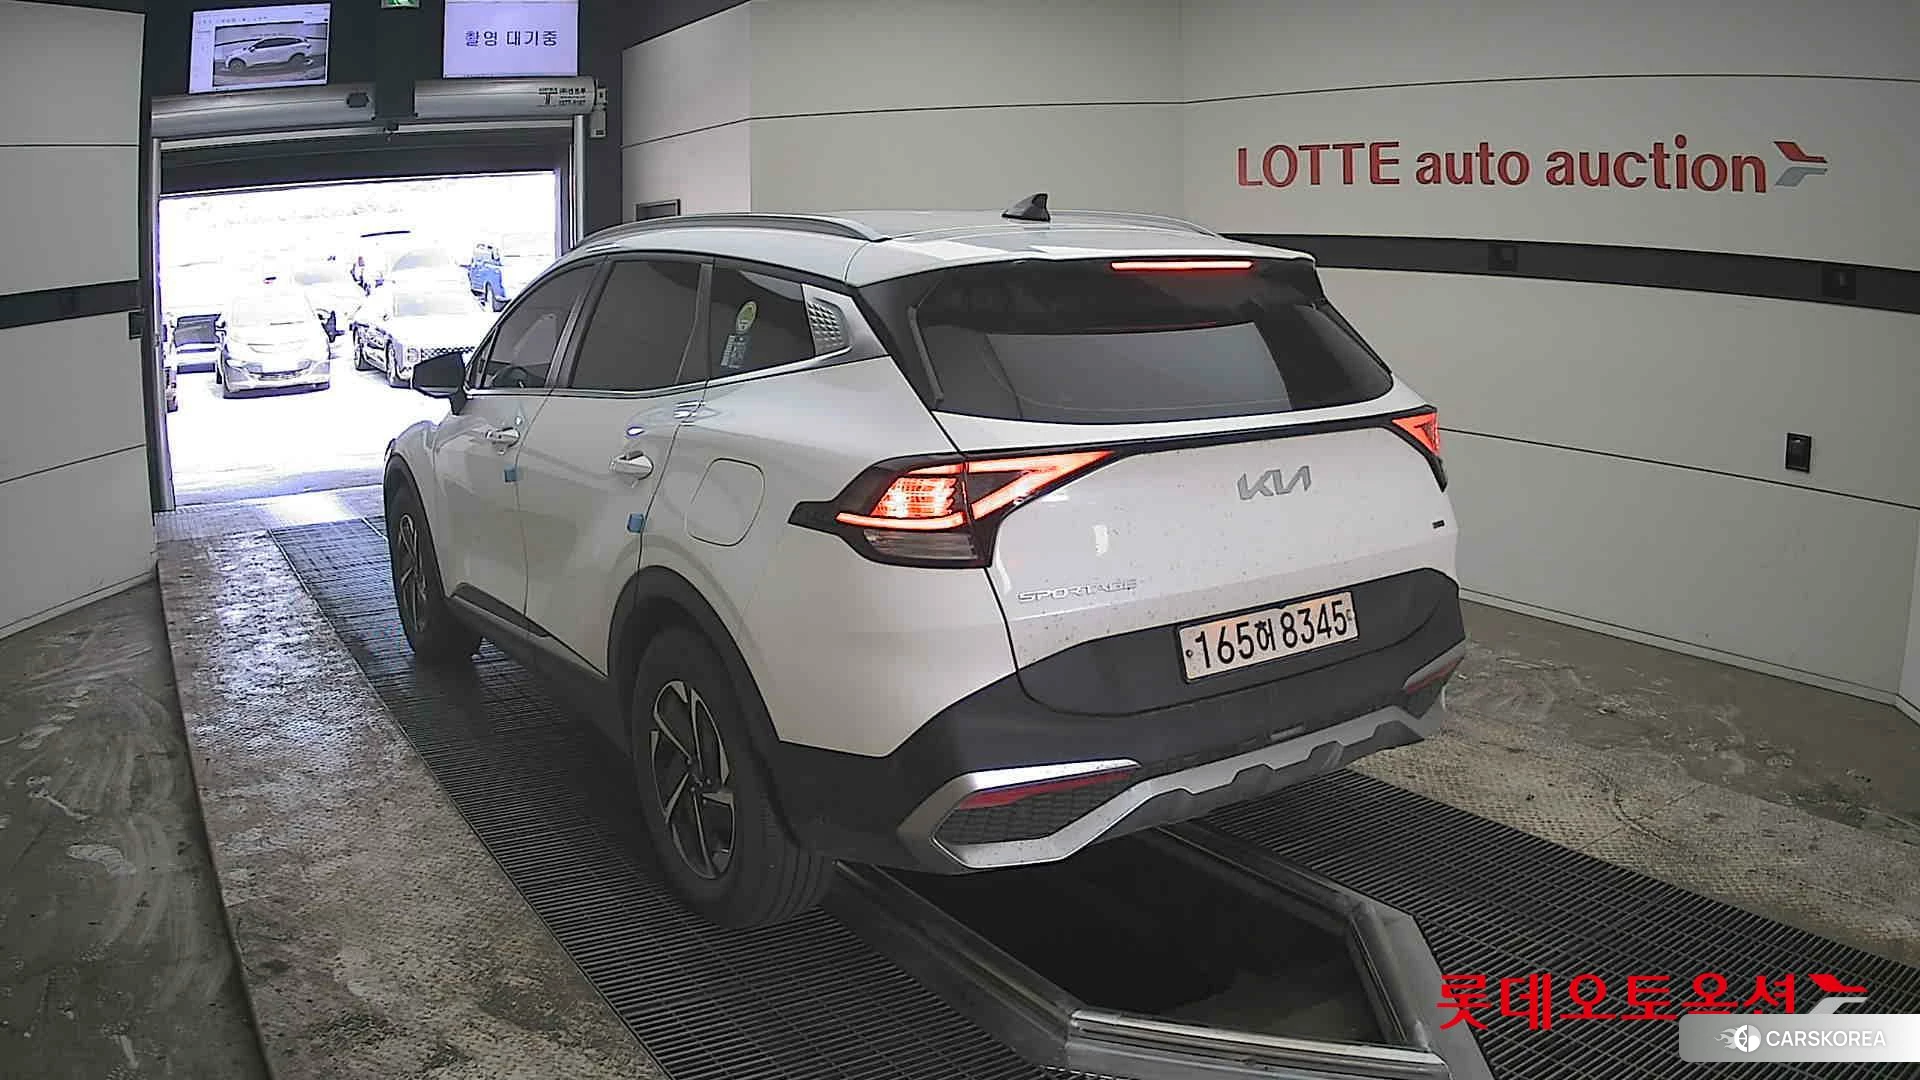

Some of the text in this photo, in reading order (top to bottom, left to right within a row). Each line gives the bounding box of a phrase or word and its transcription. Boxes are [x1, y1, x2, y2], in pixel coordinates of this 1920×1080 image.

[506, 30, 557, 47] 대기중
[1238, 134, 1767, 193] LOTTE auto auction
[1237, 465, 1311, 500] KIA
[1017, 578, 1137, 602] SPORTAGE
